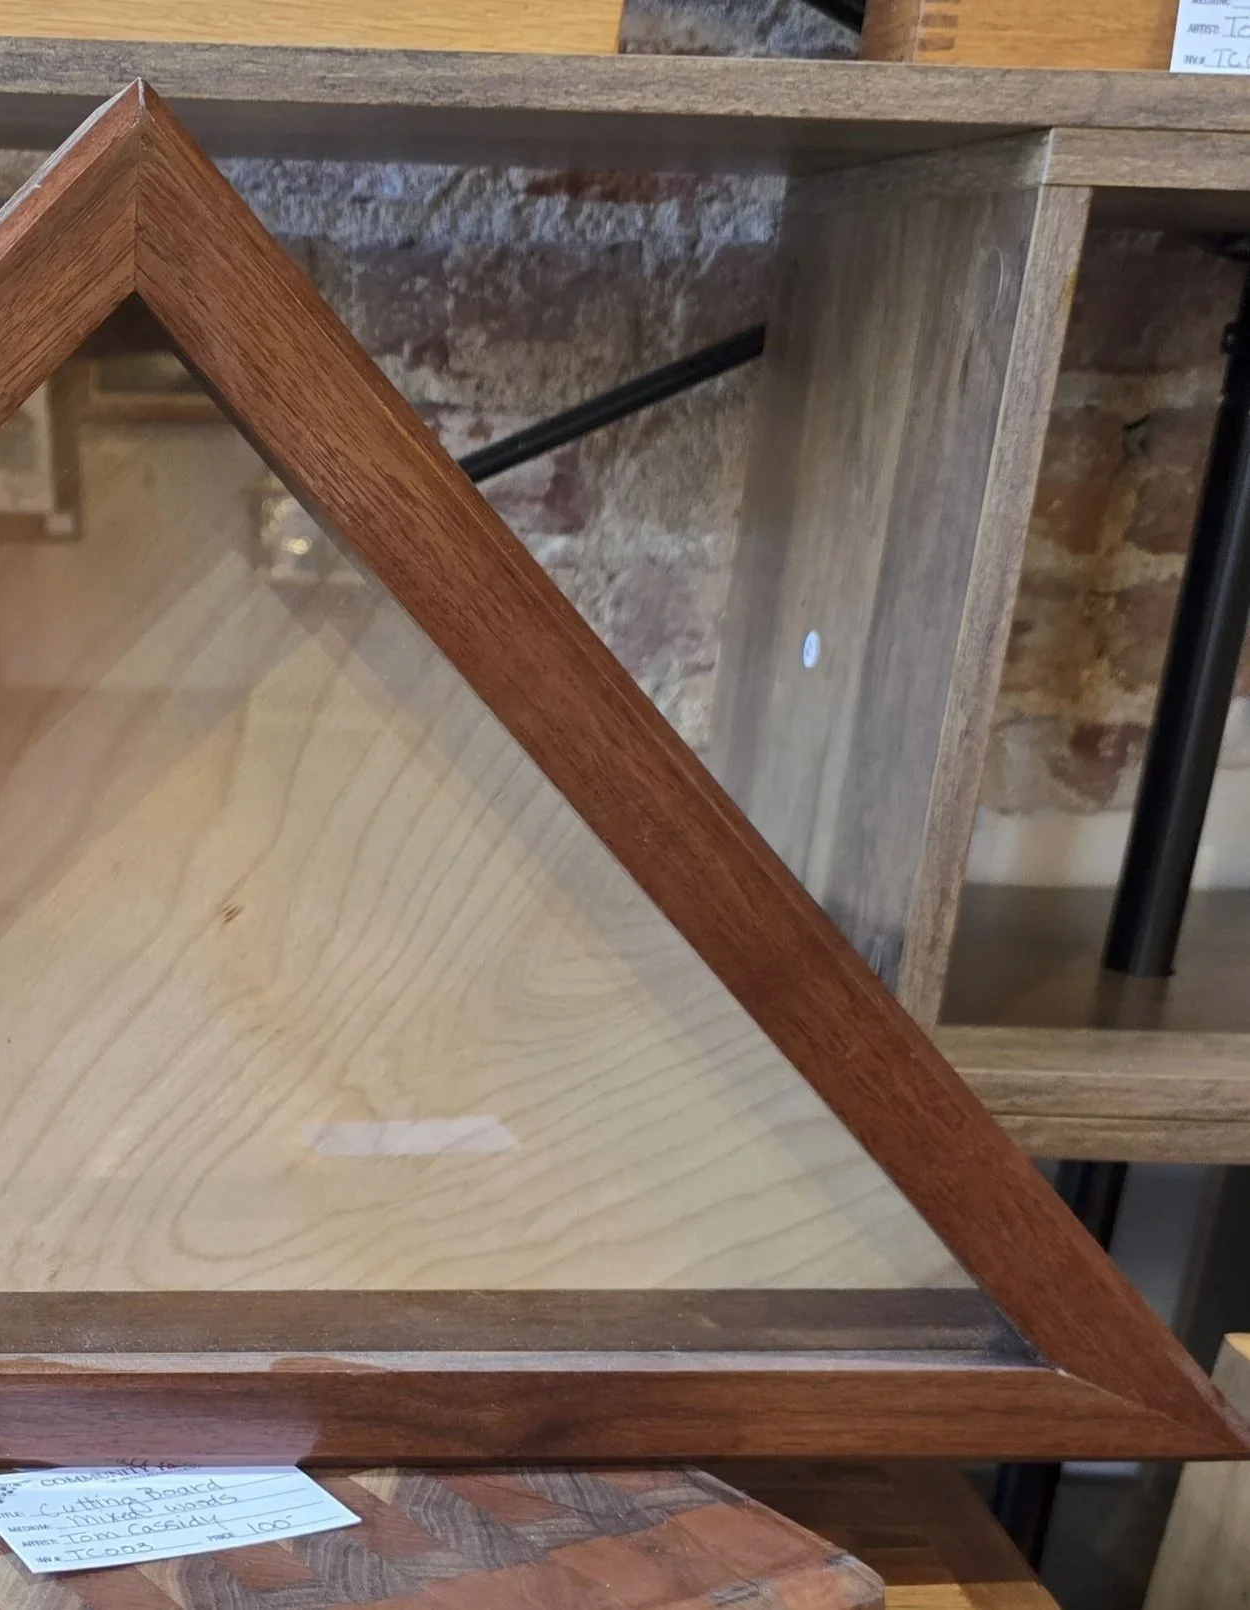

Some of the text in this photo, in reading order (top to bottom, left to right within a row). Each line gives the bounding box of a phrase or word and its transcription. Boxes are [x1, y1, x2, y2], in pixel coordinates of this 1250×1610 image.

[1187, 23, 1220, 34] ARTIST:
[40, 1465, 149, 1487] COMMUNITY
[39, 1494, 152, 1518] Cutting
[135, 1478, 223, 1501] Board
[7, 1524, 53, 1533] MEDIUM:
[59, 1531, 120, 1545] Tom
[128, 1514, 229, 1536] Cassidy
